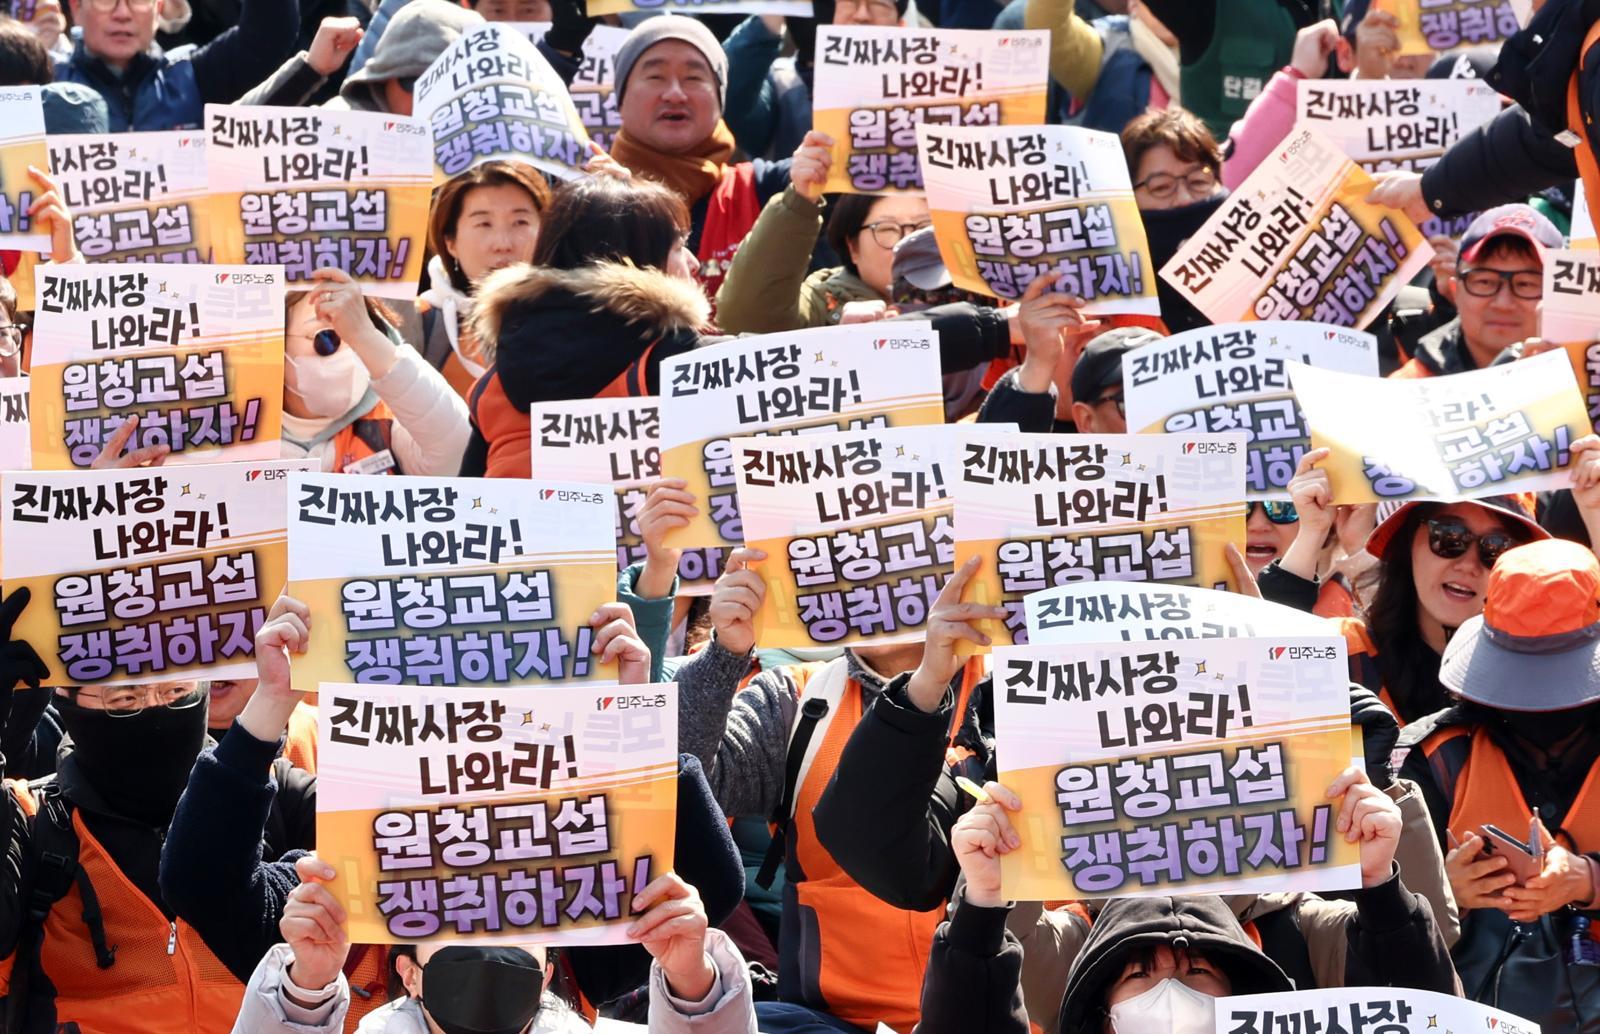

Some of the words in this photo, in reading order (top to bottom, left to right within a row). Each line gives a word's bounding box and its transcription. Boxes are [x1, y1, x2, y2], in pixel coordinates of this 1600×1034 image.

[824, 36, 940, 66] 진짜사장
[882, 63, 983, 99] 나와라!
[1306, 88, 1420, 120] 진짜사장
[212, 115, 322, 148] 진짜사장
[431, 83, 570, 142] 원청교섭
[1367, 112, 1458, 153] 나와라!
[264, 145, 368, 182] 나와라!
[926, 133, 1047, 170] 진짜사장
[63, 164, 168, 207] 나와라!
[989, 160, 1093, 206] 나와라!
[240, 190, 387, 235] 원청교섭
[965, 204, 1116, 258] 원청교섭
[1241, 186, 1314, 278] 나와라!
[1174, 199, 1262, 294] 진짜사장
[42, 273, 148, 313] 진짜사장
[232, 273, 275, 285] 민주노총
[91, 302, 200, 350] 나와라!
[889, 338, 930, 350] 민주노총
[62, 350, 228, 413] 원청교섭
[672, 344, 802, 398] 진짜사장
[1131, 329, 1257, 388] 진짜사장
[736, 369, 862, 424] 나와라!
[1164, 398, 1311, 444] 청교
[742, 439, 882, 488] 진짜사장
[963, 443, 1108, 485] 진짜사장
[1198, 442, 1238, 455] 민주노총
[264, 468, 309, 480] 민주
[557, 490, 604, 504] 민주노총
[816, 463, 947, 523] 나와라!
[12, 476, 168, 524] 진짜사장
[298, 484, 458, 526] 진짜사장
[1034, 475, 1169, 527] 나와라!
[93, 502, 230, 560] 나와라!
[381, 519, 524, 567] 나와라!
[996, 526, 1194, 593] 원청교섭
[54, 550, 261, 627] 원청교섭
[341, 568, 556, 633] 원청교섭
[1036, 593, 1192, 630] 진짜사장
[344, 625, 593, 686] 쟁취하자!
[1288, 646, 1337, 660] 민주노총
[617, 694, 667, 710] 민주노총
[1004, 651, 1181, 705] 진짜사장
[330, 697, 506, 748] 진짜사장
[1097, 684, 1254, 749] 나와라!
[419, 735, 578, 796] 나와라!
[1053, 741, 1291, 828] 원청교섭
[373, 793, 612, 872] 원청교섭
[1060, 804, 1333, 894] 쟁취하자!
[376, 855, 656, 939] 쟁취하자!
